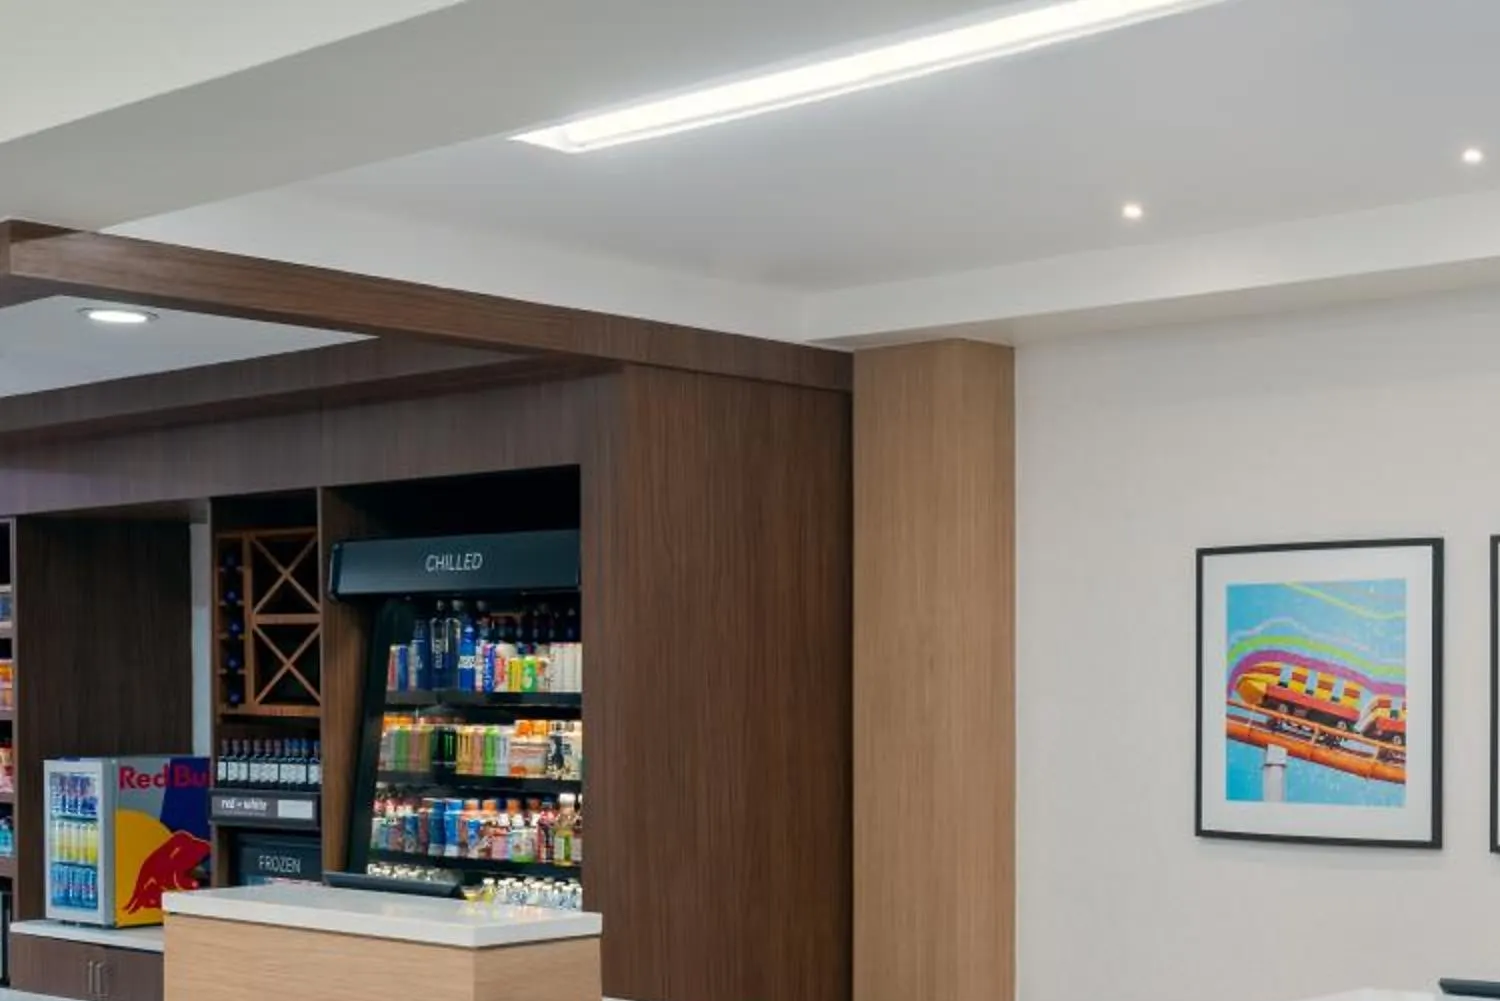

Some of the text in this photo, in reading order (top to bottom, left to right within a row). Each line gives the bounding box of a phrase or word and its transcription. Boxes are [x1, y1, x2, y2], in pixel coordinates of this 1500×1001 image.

[425, 552, 483, 572] CHILLED
[118, 763, 169, 790] Red
[258, 854, 301, 874] FROZEN
